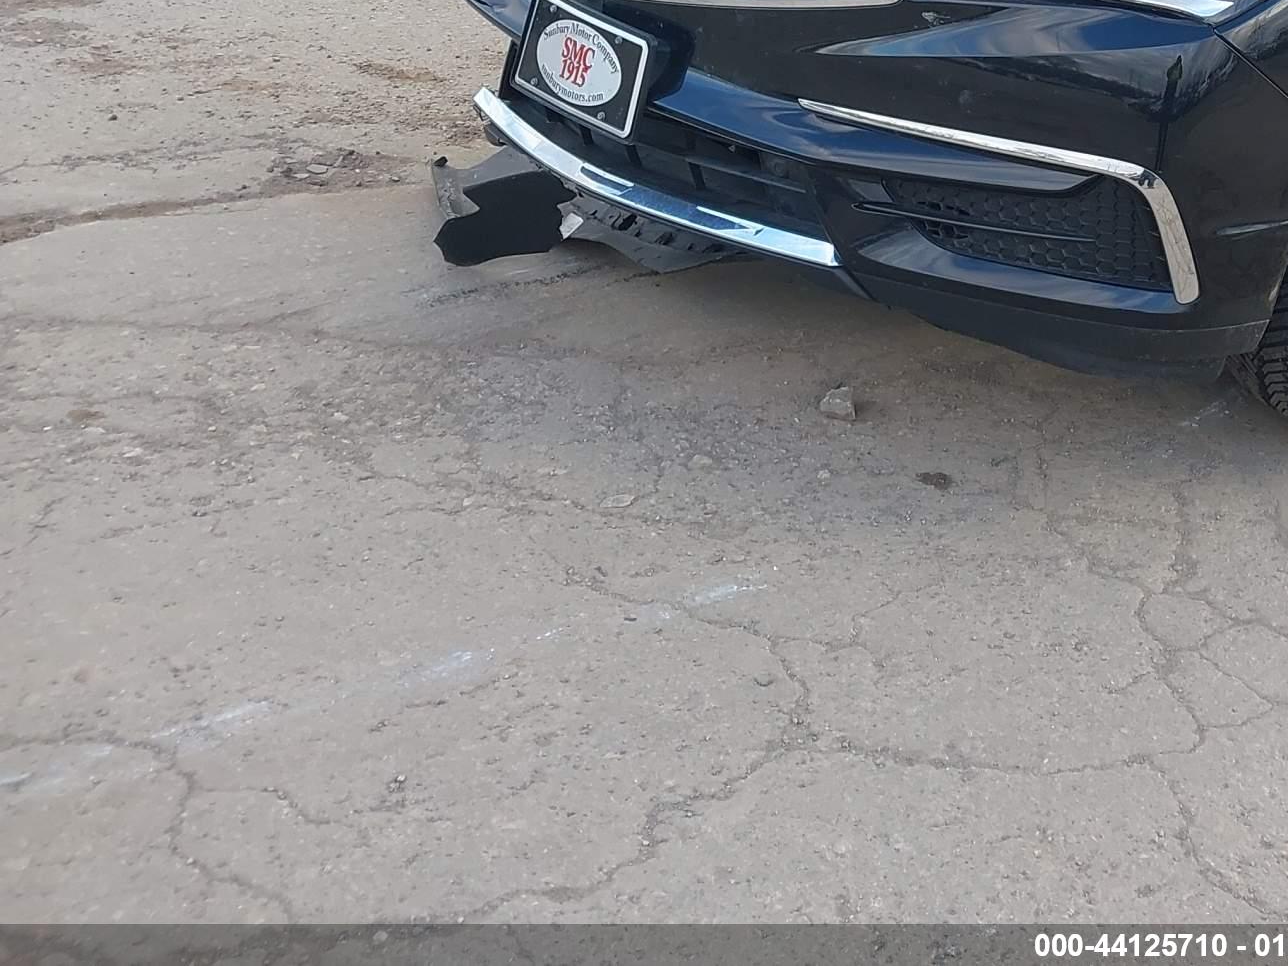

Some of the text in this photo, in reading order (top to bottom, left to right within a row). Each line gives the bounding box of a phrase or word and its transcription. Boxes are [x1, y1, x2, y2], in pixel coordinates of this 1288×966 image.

[543, 22, 620, 75] Sunbury Motor Company
[562, 36, 596, 68] SMC
[559, 59, 592, 88] 1915
